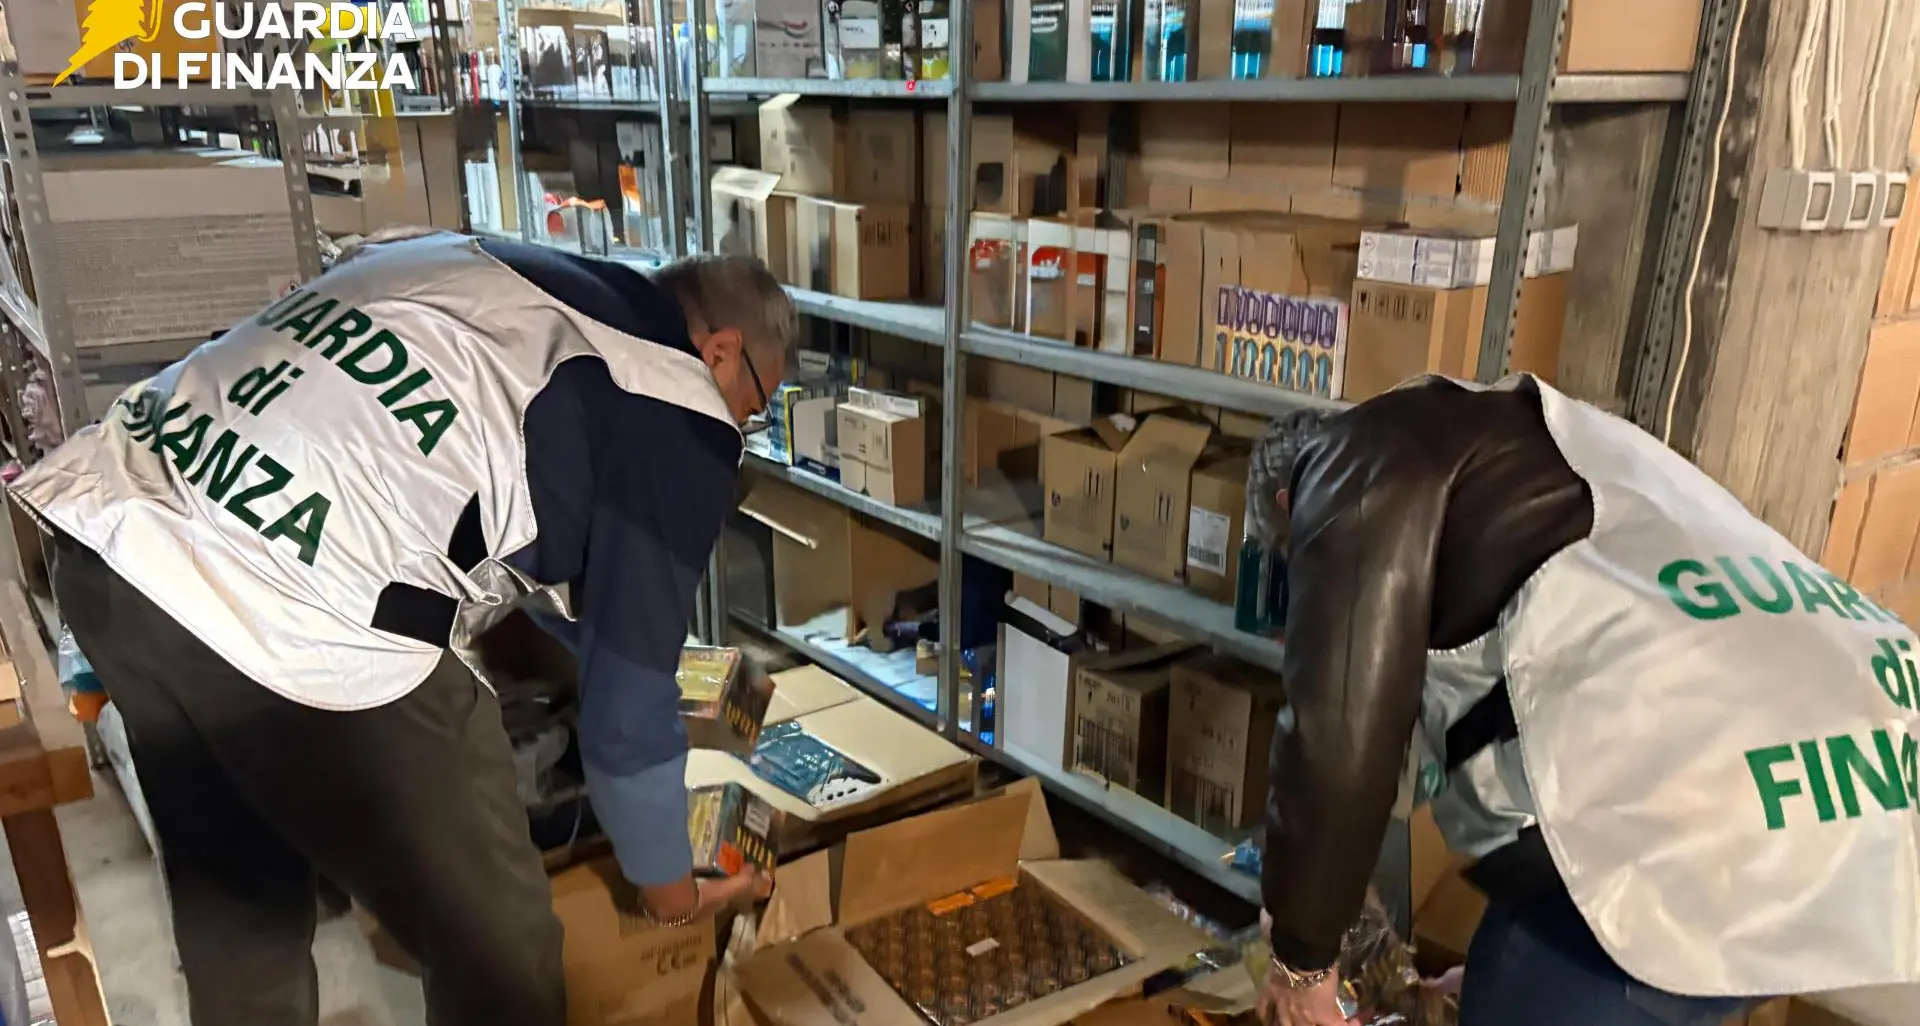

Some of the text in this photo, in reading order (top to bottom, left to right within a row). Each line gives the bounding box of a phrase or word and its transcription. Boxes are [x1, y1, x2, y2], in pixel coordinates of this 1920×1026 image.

[227, 361, 304, 416] di
[257, 288, 459, 457] UARDIA
[1658, 555, 1900, 622] GUAR
[1871, 638, 1920, 712] di
